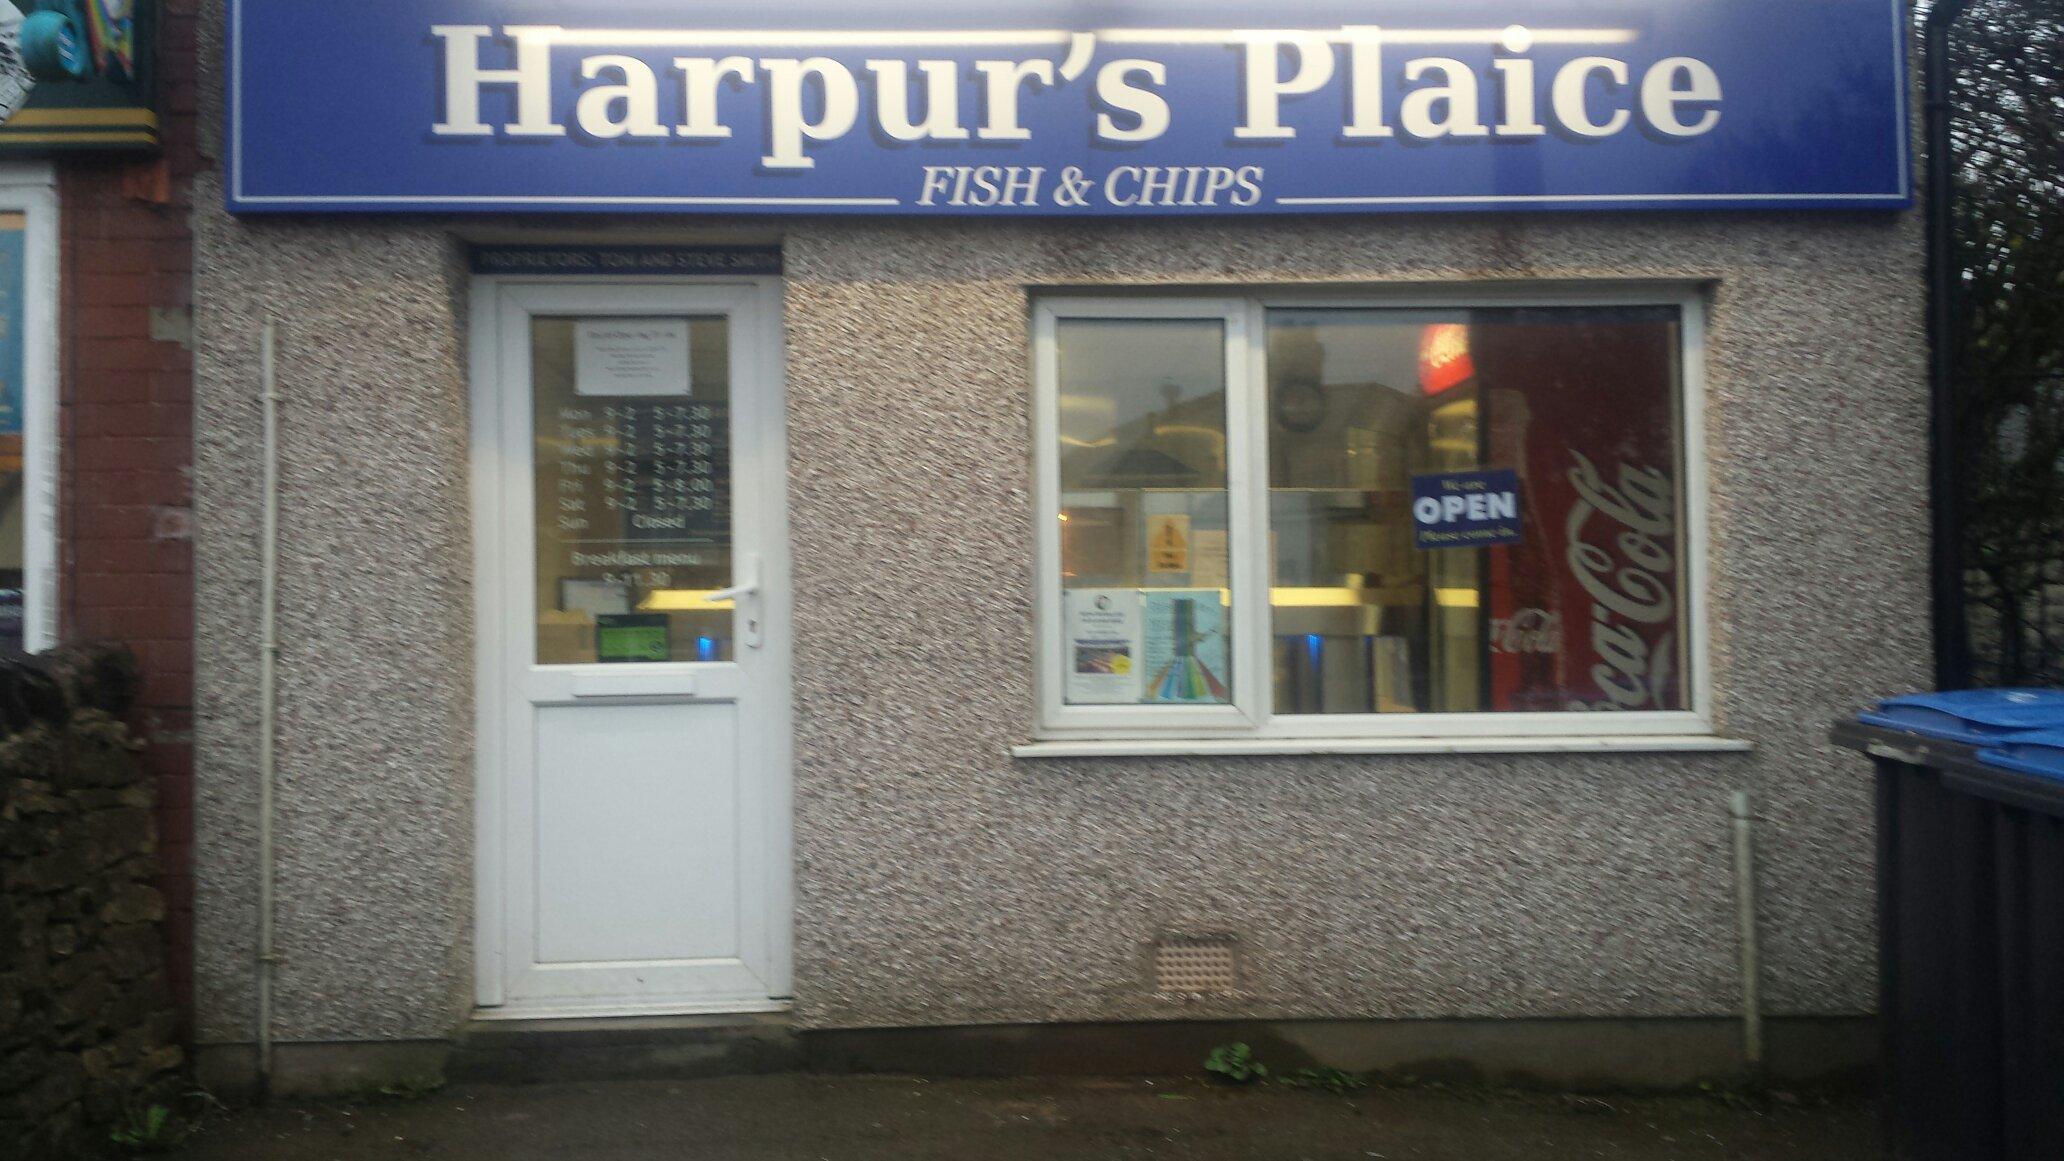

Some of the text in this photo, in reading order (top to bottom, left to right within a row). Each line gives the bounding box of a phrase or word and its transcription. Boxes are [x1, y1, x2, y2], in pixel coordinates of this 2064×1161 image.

[1232, 25, 1722, 140] Plaice
[915, 166, 1265, 207] FISH & CHIPS
[632, 512, 686, 529] Closed
[1412, 491, 1517, 525] OPEN
[570, 551, 703, 566] Breakfast menu
